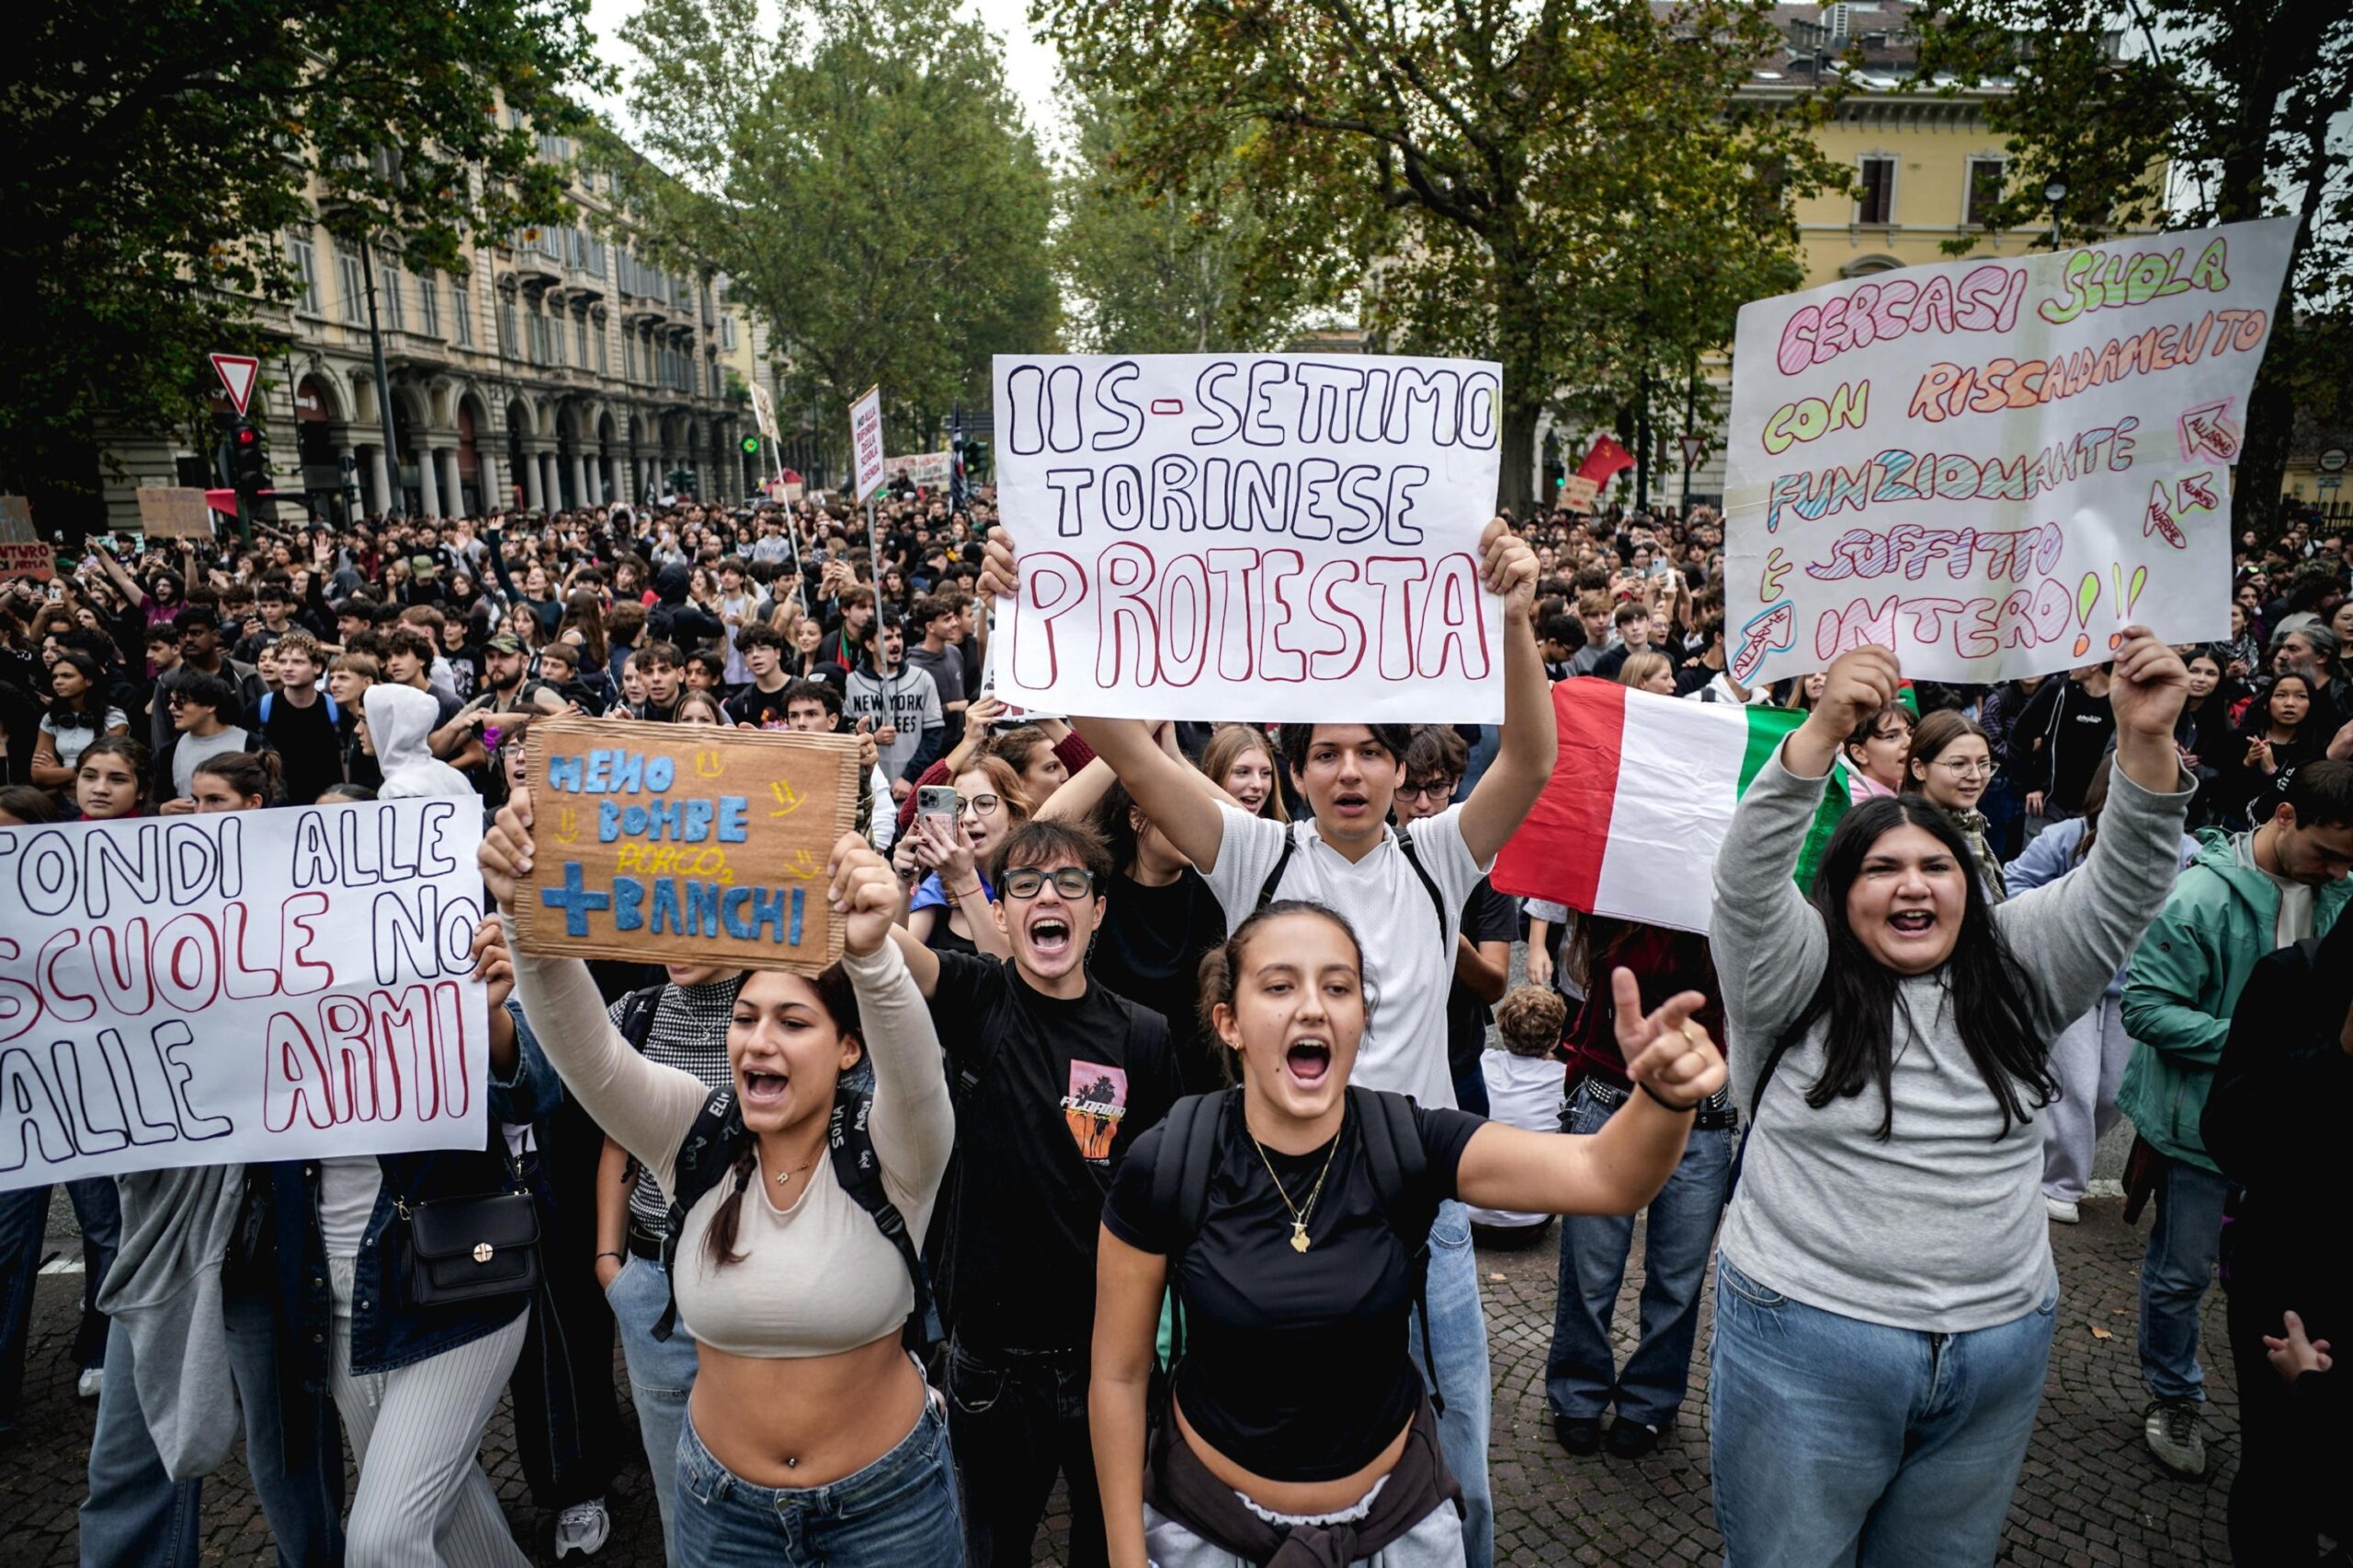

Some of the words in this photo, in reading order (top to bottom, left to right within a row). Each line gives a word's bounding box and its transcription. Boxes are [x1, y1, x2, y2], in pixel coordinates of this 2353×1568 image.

[1778, 265, 2028, 375] CERCASI
[1762, 379, 1870, 455] CON
[1908, 309, 2268, 423] RISCALDAMENTO
[1767, 416, 2140, 533] FUNZIONANTE
[2188, 416, 2234, 456] ALLARME
[1046, 453, 1429, 545] TORINESE
[1805, 522, 2063, 582] SOFFITTO
[1013, 541, 1491, 689] PROTESTA
[1733, 608, 1788, 681] ALLARME
[854, 694, 882, 712] NEW
[888, 694, 924, 711] YORK
[292, 802, 456, 889] ALLE
[599, 796, 748, 843] BOMBE
[613, 877, 805, 946] BANCHI
[0, 891, 335, 1042] SCUOLE
[371, 885, 483, 986] NO
[0, 1019, 233, 1172] ALLE
[264, 981, 470, 1132] ARMI
[1060, 1096, 1126, 1119] FLORIDA
[831, 1104, 846, 1149] SOFIA
